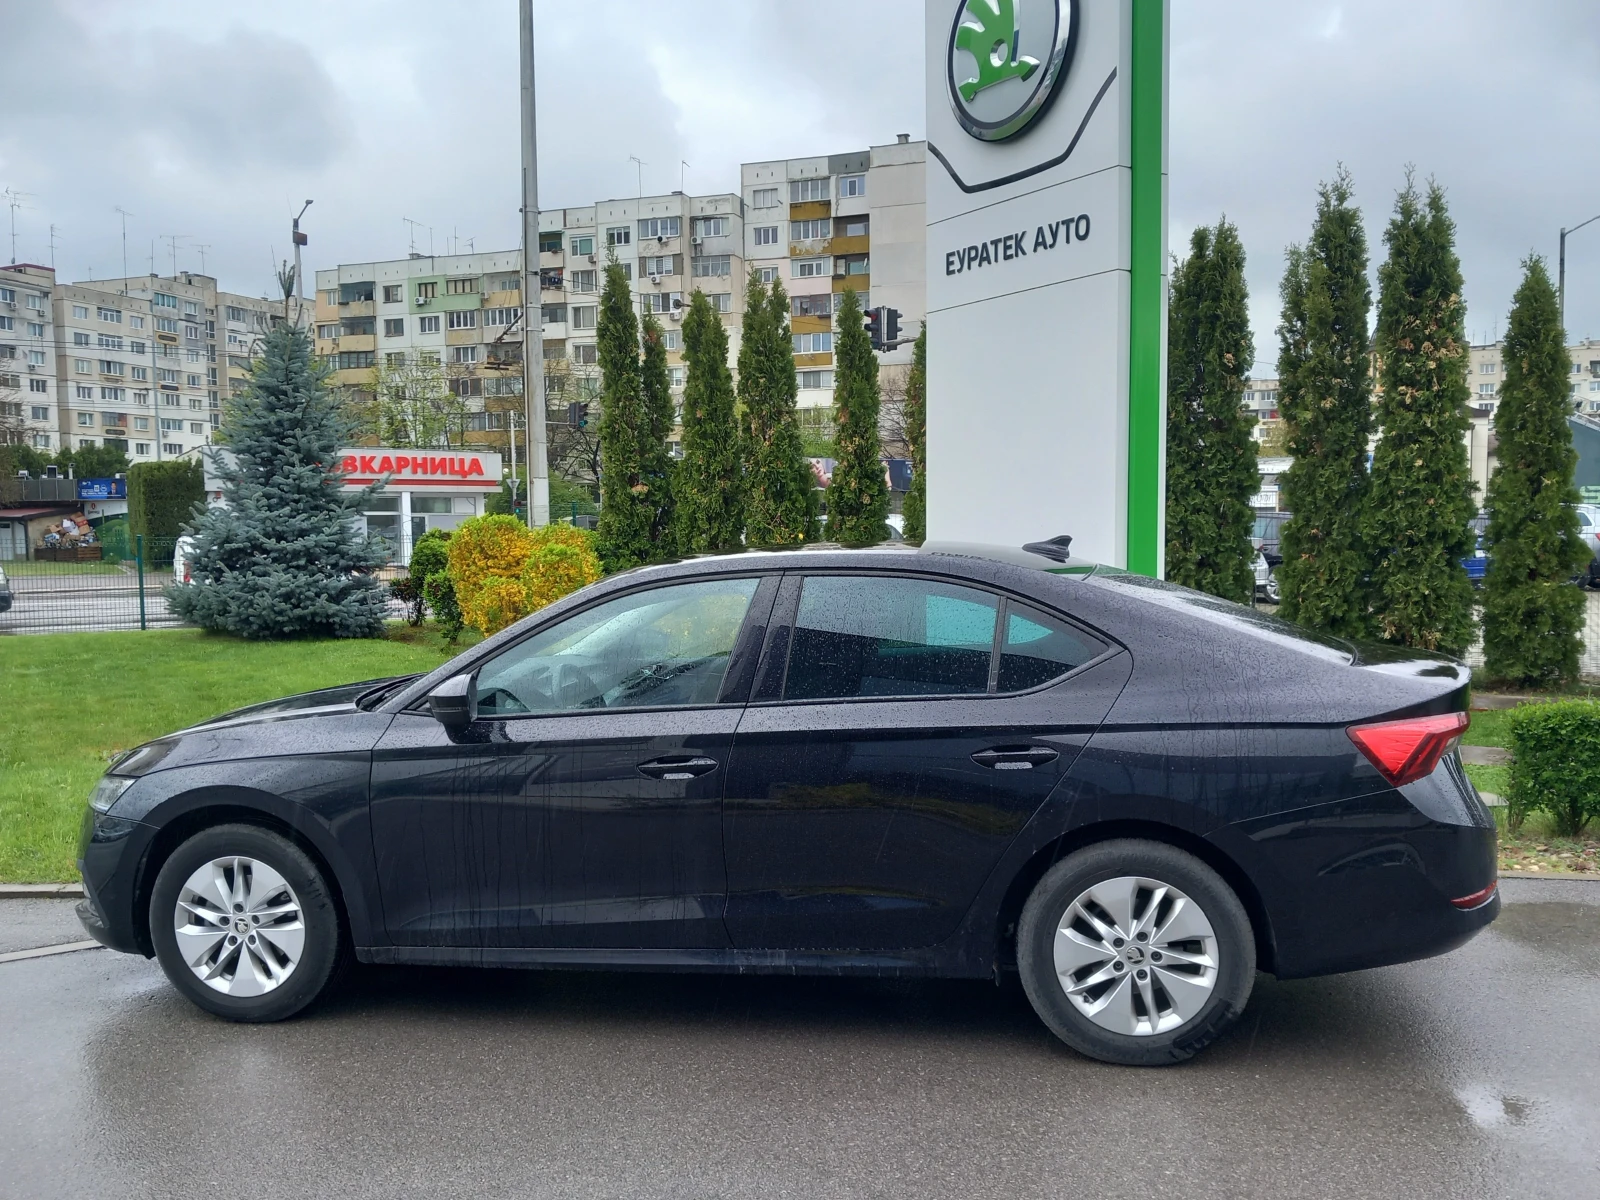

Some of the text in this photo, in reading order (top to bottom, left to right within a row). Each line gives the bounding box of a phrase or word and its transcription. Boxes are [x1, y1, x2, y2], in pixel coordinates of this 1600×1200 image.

[945, 213, 1091, 276] ЕУРАТЕК АУТО
[329, 455, 485, 479] ВКАРНИЦА
